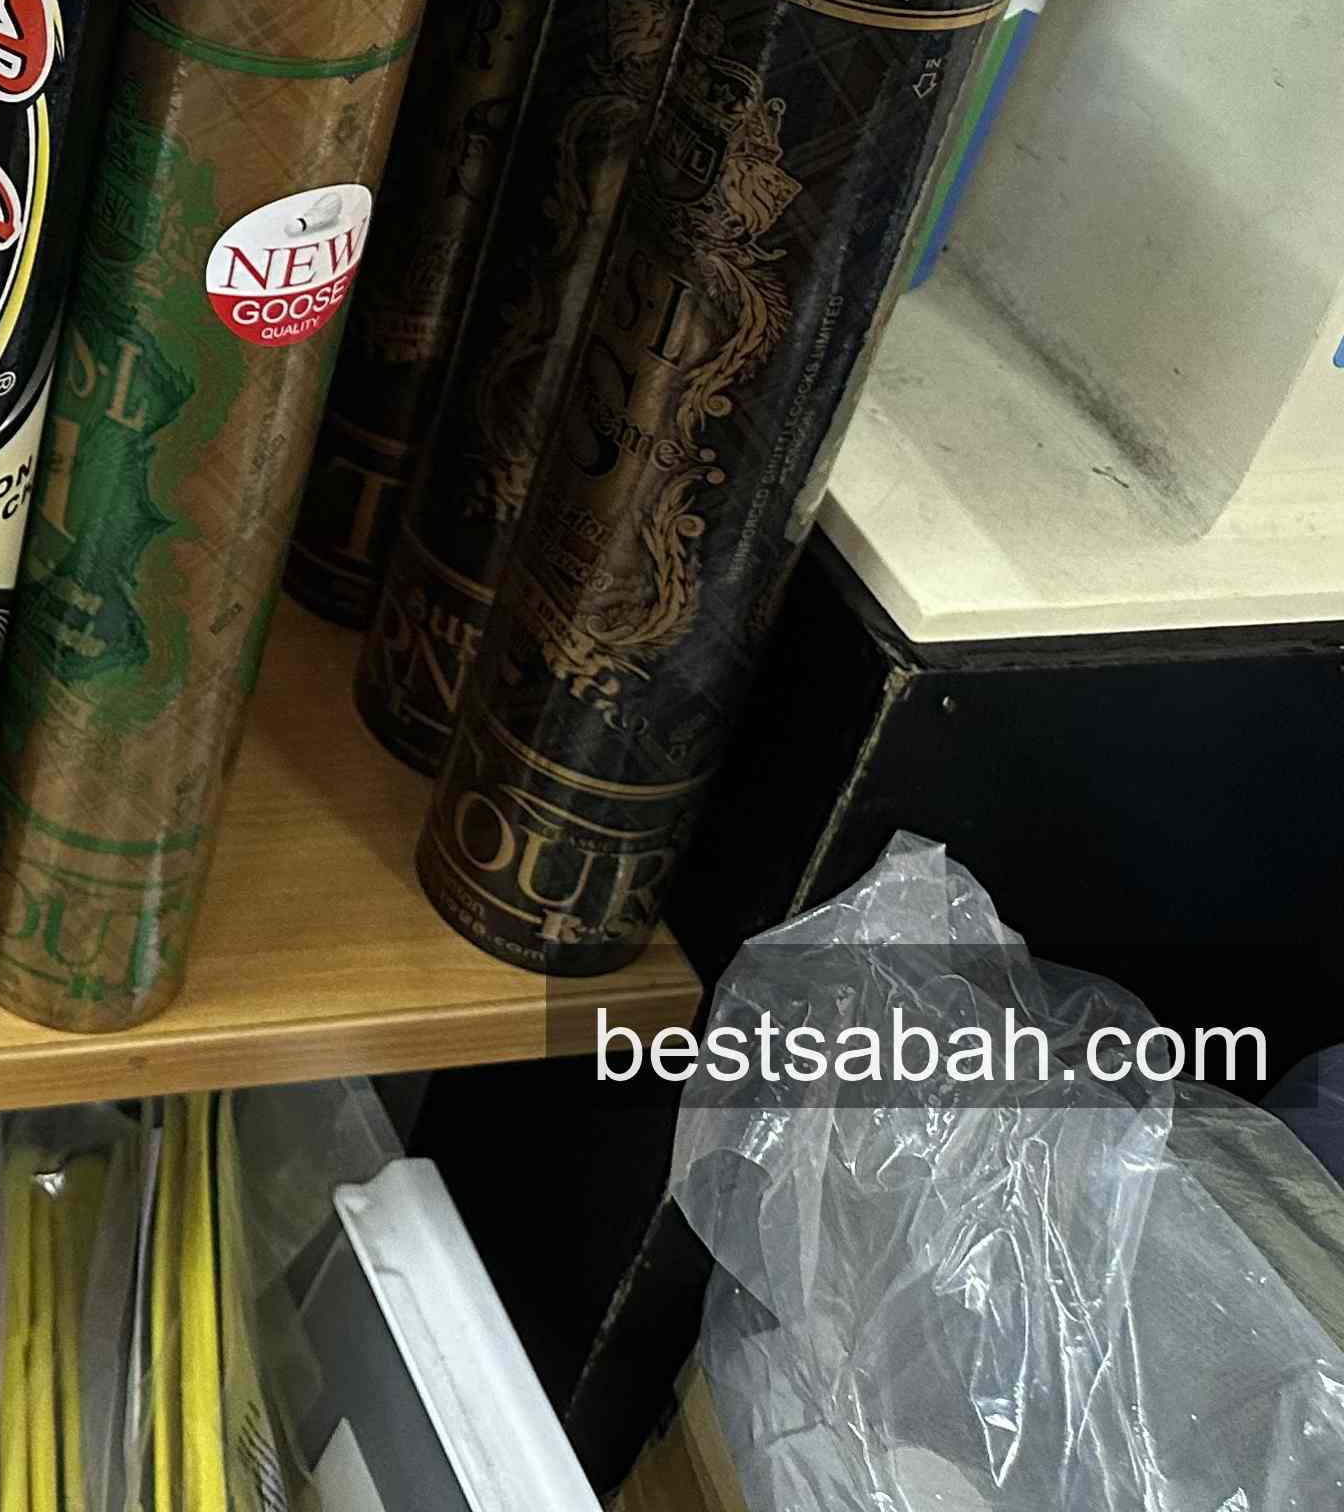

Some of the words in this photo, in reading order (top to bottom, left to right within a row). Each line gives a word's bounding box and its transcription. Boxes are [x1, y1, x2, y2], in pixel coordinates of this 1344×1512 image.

[218, 215, 369, 291] NEW
[232, 275, 349, 325] GOOSE
[261, 316, 322, 340] QUALITY
